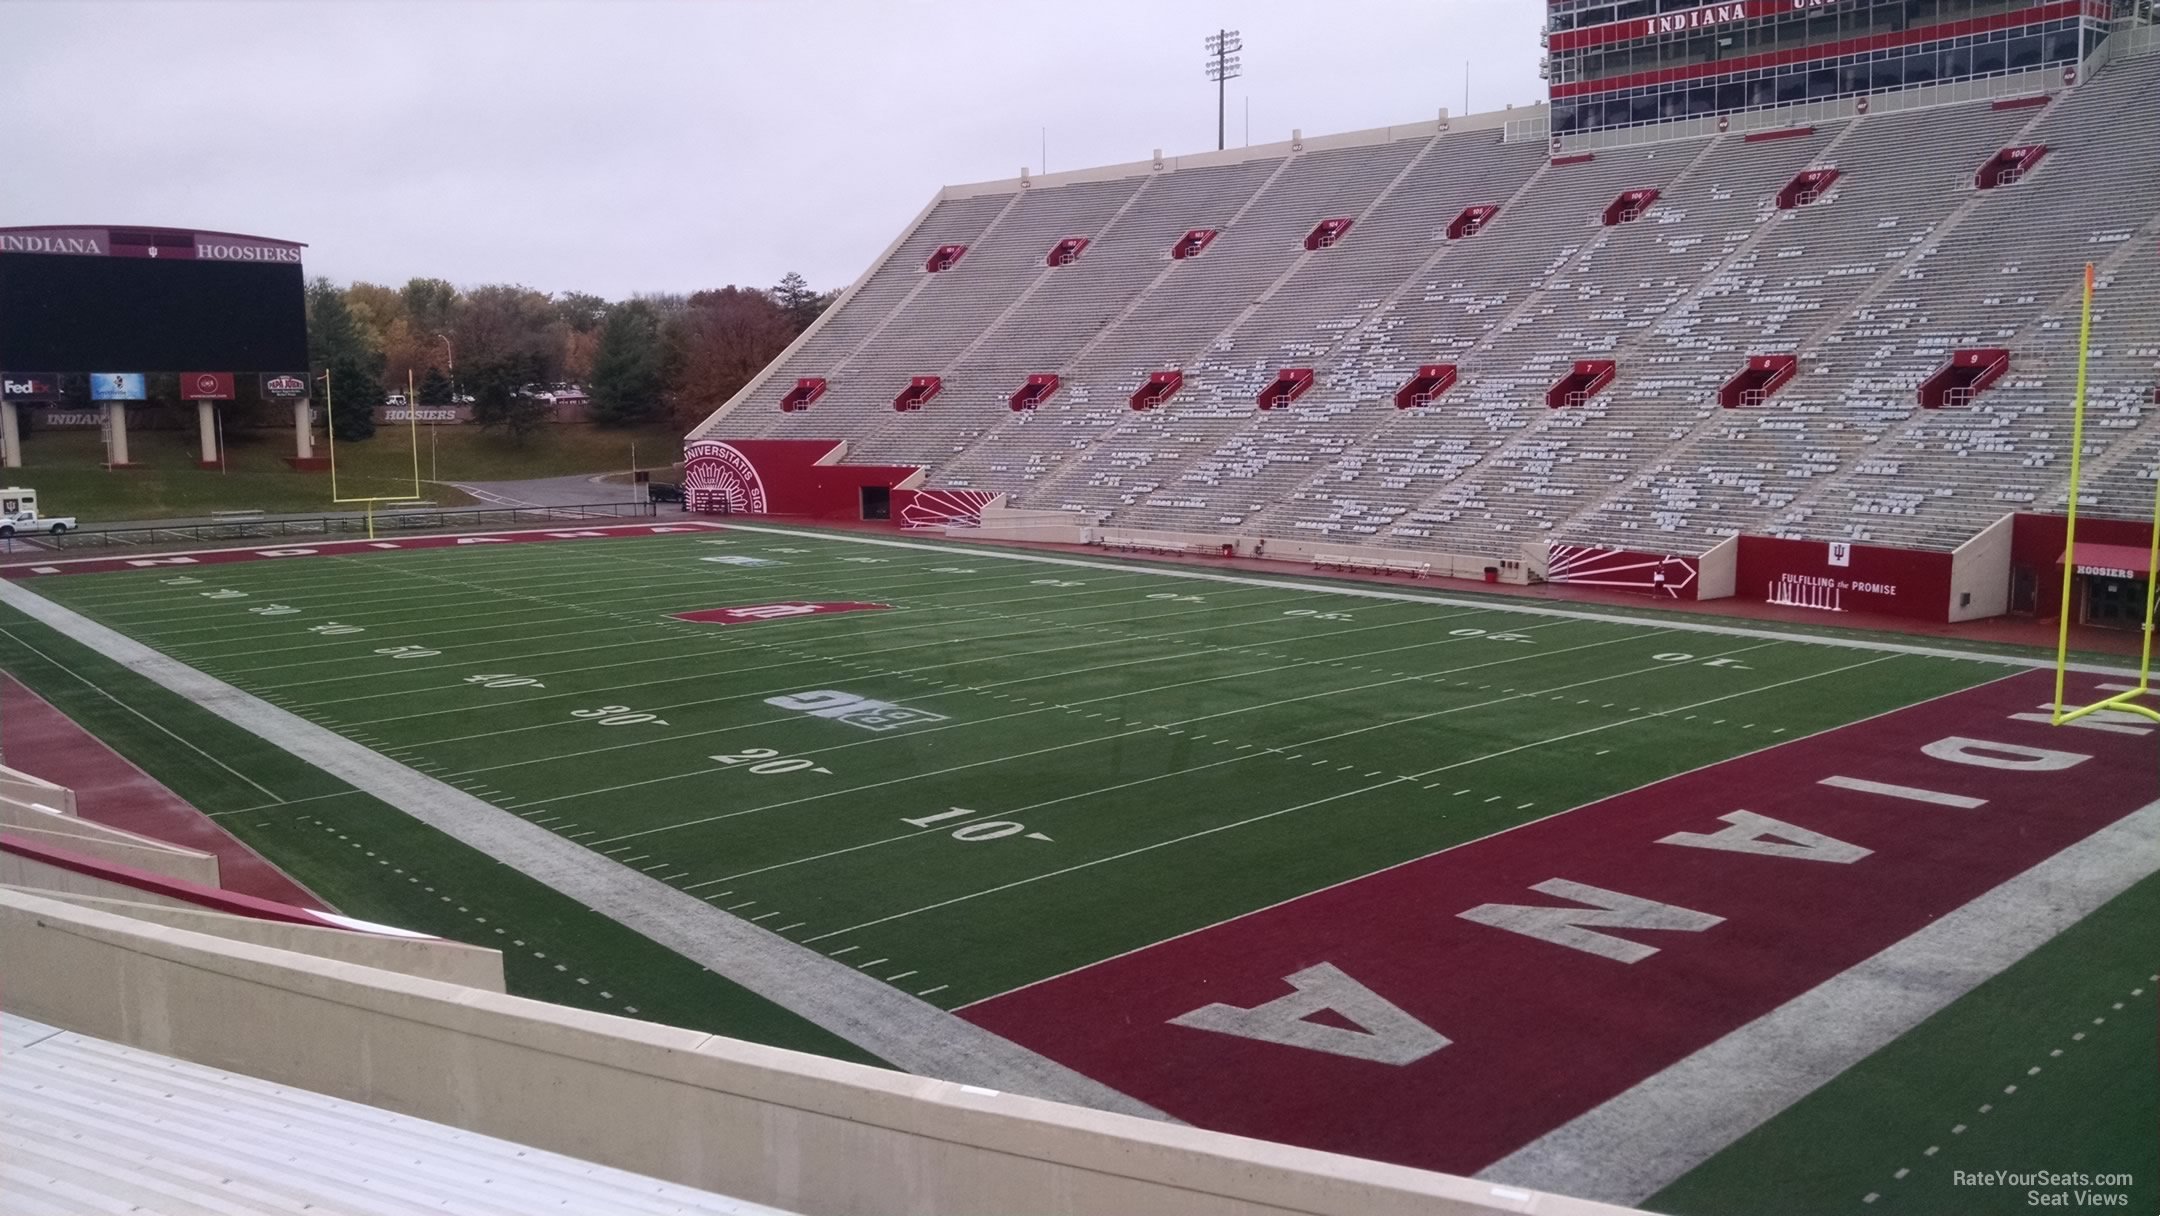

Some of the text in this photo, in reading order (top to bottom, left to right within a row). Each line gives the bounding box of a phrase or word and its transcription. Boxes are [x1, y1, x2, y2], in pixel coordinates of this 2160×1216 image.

[1648, 4, 1745, 34] INDIANA
[2011, 149, 2026, 158] 108
[1631, 192, 1643, 200] 106
[0, 235, 101, 254] INDIANA
[197, 244, 300, 262] HOOSIERS
[1764, 359, 1771, 368] 8
[1970, 354, 1978, 364] 9
[1587, 364, 1592, 372] 7
[4, 380, 49, 394] FedEx
[385, 410, 456, 421] HOOSIERS
[2077, 566, 2134, 579] HOOSIERS
[1782, 573, 1896, 595] FULFILLING the PROMISE
[463, 673, 538, 688] 40
[570, 705, 657, 726] 30
[708, 748, 814, 774] 20
[900, 806, 1025, 841] 10
